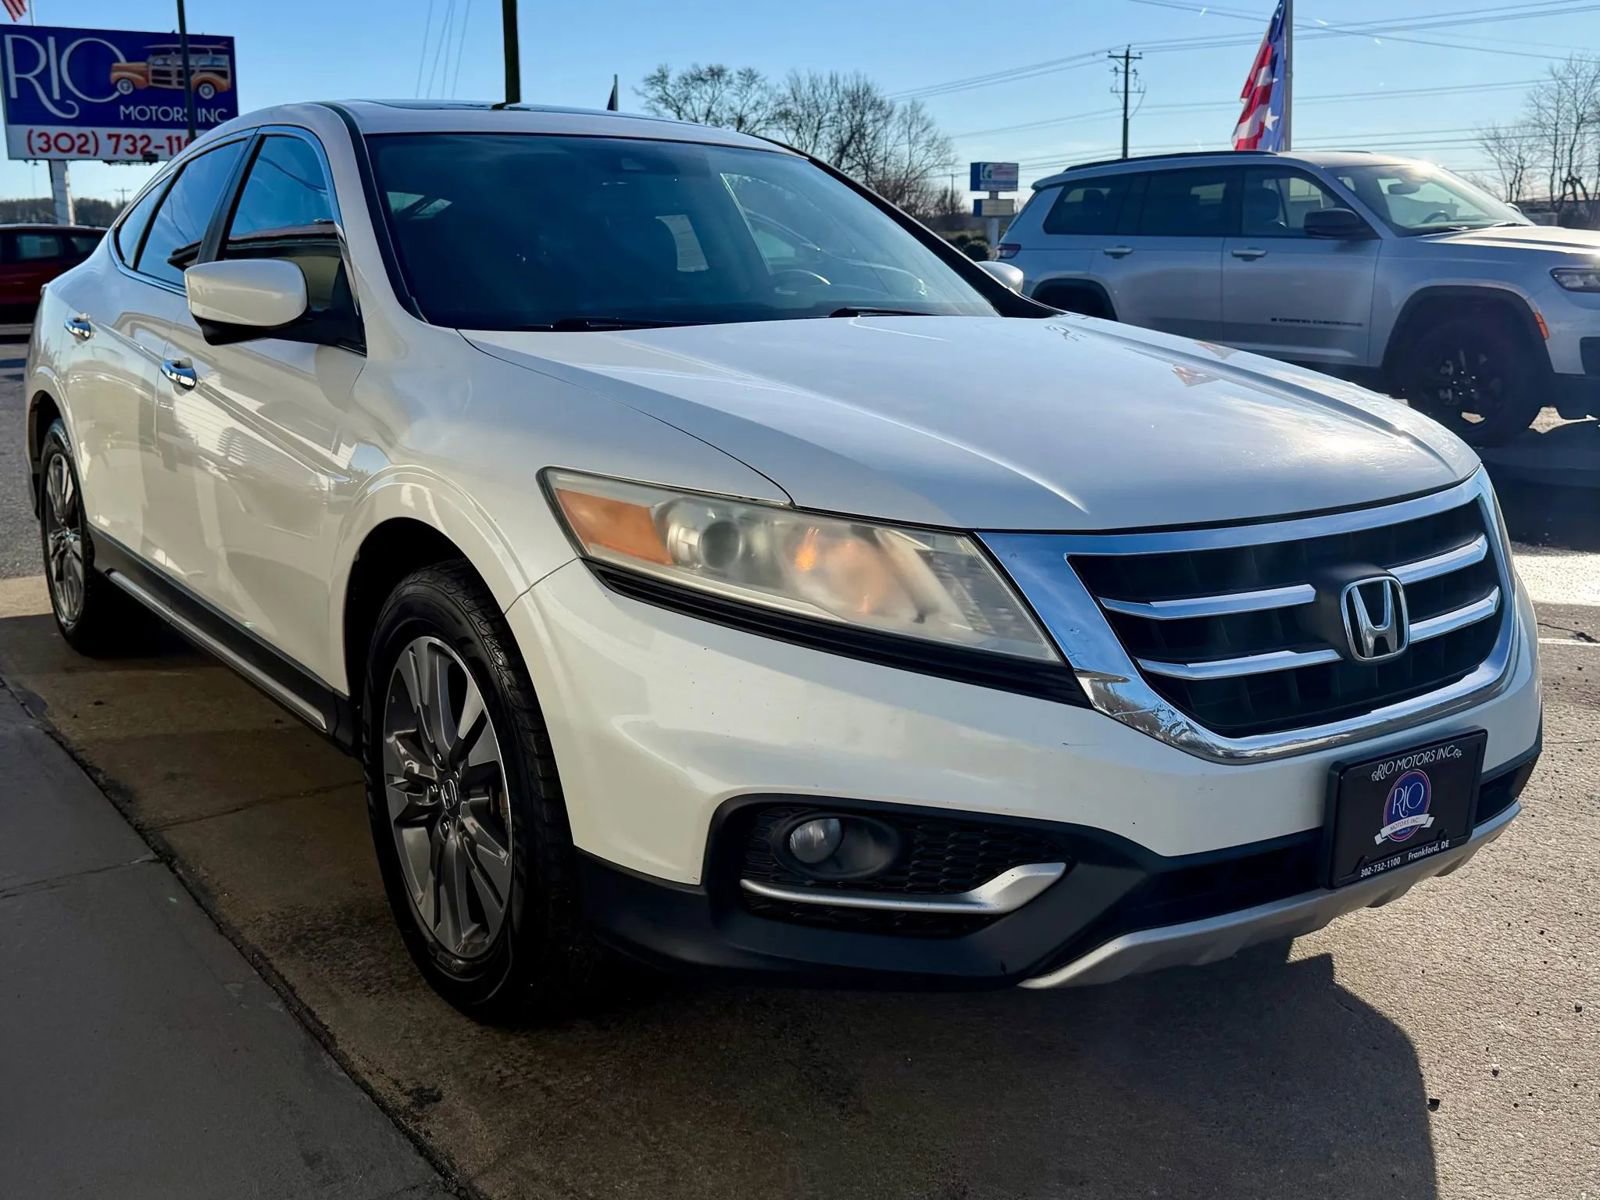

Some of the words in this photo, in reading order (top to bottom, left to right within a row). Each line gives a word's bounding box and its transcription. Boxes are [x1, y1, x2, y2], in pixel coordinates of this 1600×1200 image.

[4, 34, 127, 119] RIO
[197, 107, 228, 123] INC
[27, 129, 99, 157] (302)
[1376, 761, 1395, 780] RIO
[1395, 750, 1436, 772] MOTORS
[1436, 744, 1455, 760] INC
[1392, 782, 1424, 818] RIO
[1360, 856, 1401, 878] 302-732-1100
[1440, 839, 1450, 849] DE
